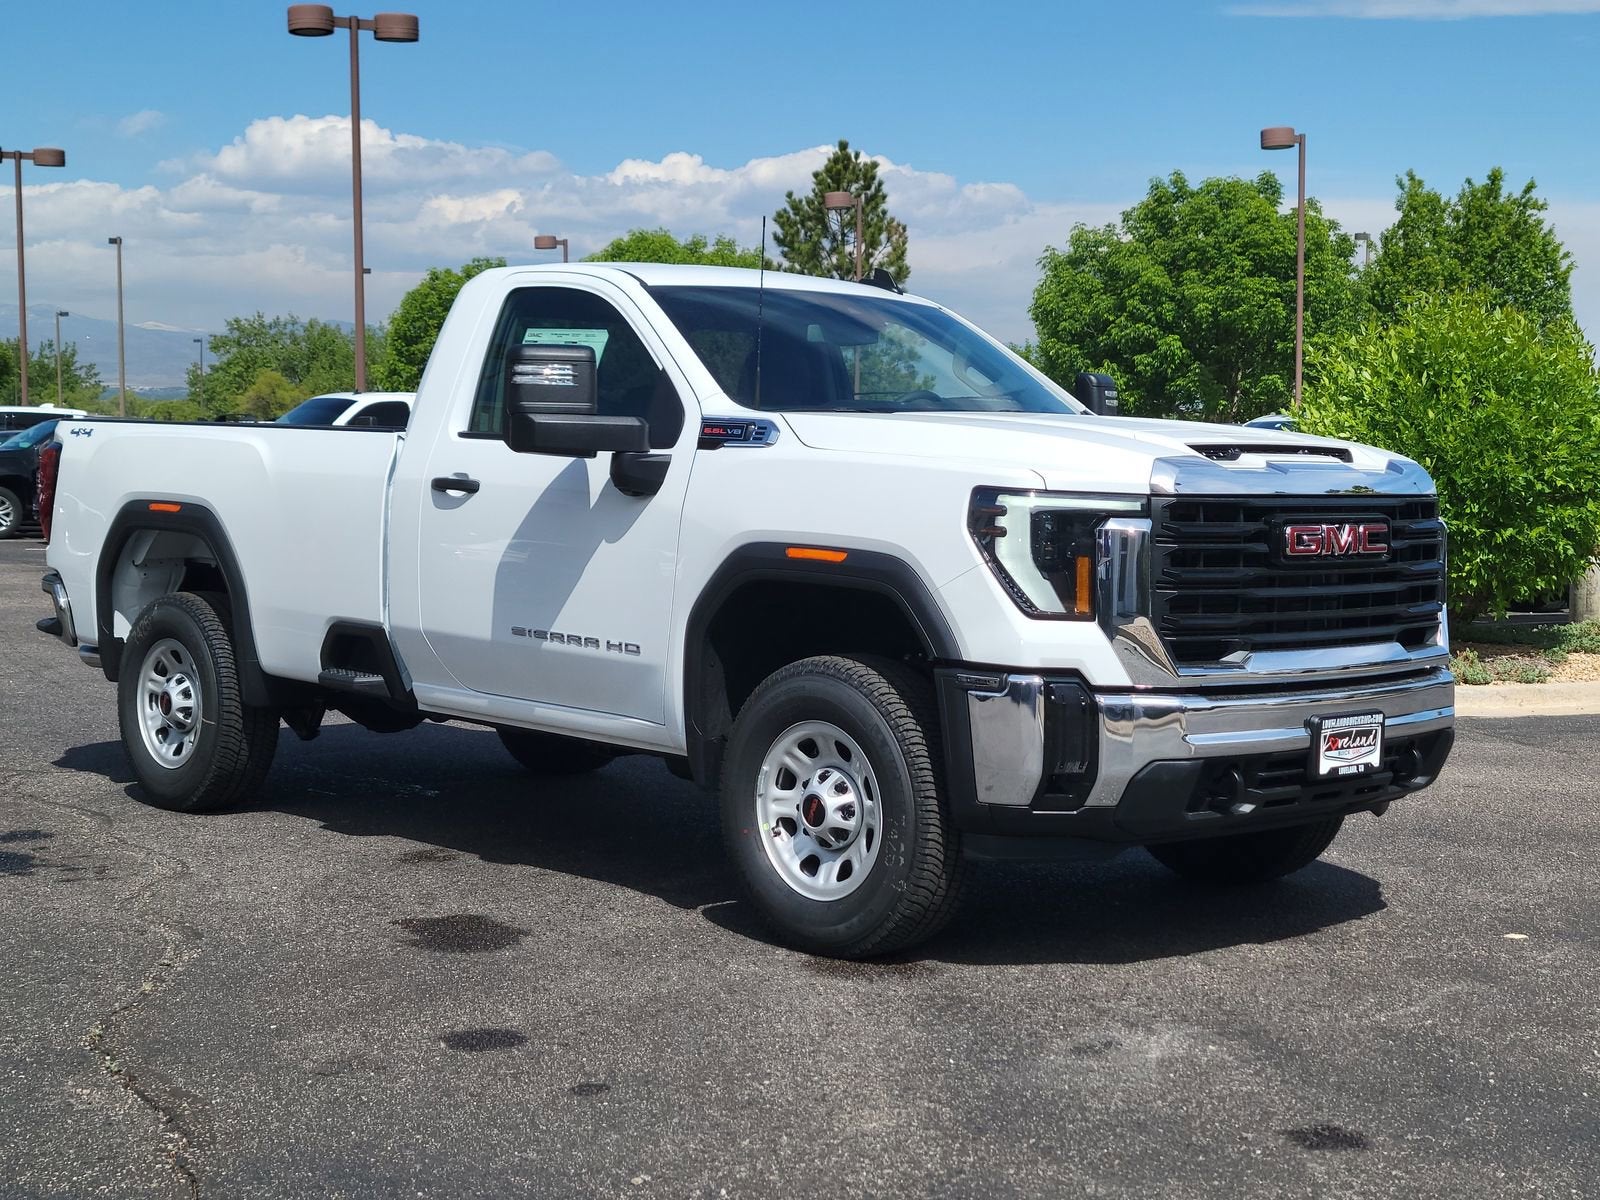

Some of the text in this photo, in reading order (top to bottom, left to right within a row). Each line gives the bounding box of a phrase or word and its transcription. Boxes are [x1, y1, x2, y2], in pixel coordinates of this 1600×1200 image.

[1285, 523, 1388, 555] GMC
[511, 625, 641, 656] SIERRA HD
